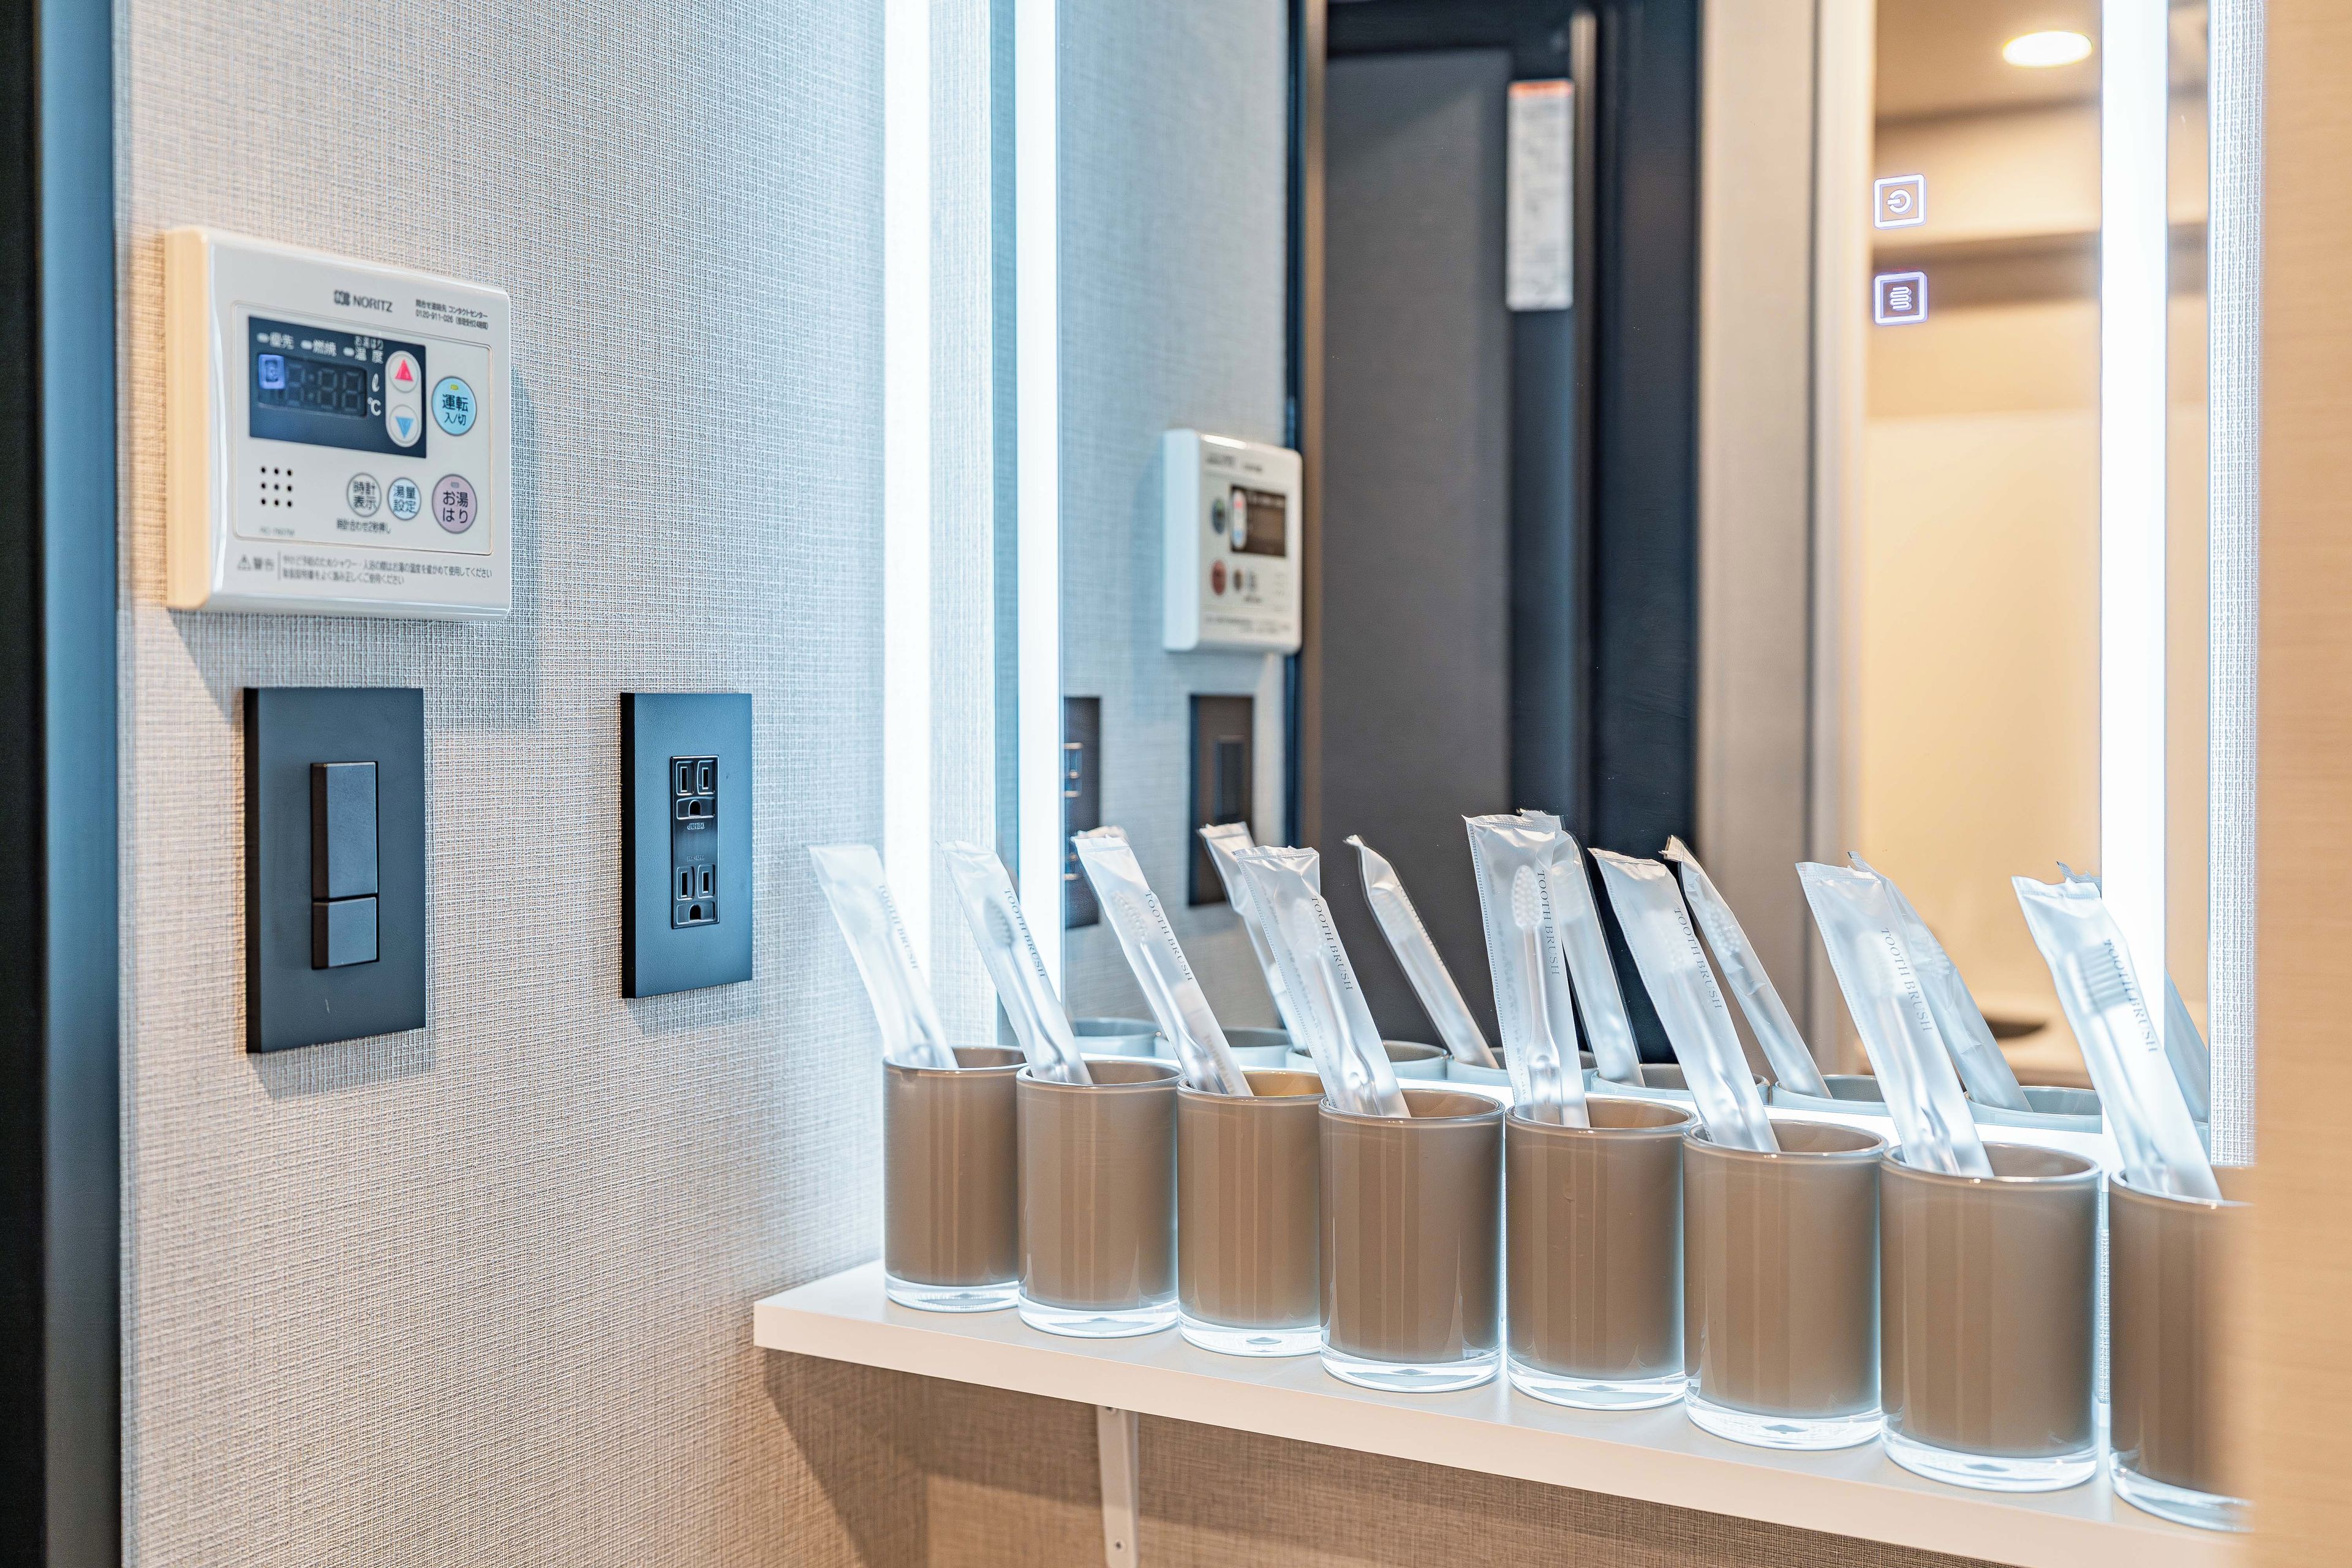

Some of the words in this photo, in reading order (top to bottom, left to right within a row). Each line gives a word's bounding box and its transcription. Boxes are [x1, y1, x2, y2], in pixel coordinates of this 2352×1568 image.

[353, 295, 393, 313] NORITZ
[448, 305, 488, 318] コンタクトセンター
[442, 394, 468, 412] 運転
[444, 412, 466, 426] 入/切
[353, 481, 375, 496] 時計
[393, 484, 416, 499] 湯量
[353, 496, 377, 511] 表示
[393, 499, 417, 514] 設定
[443, 491, 469, 508] お湯
[442, 507, 468, 524] はり
[878, 884, 900, 924] TOOTH
[897, 928, 919, 969] BRUSH
[1537, 870, 1551, 920] TOOTH
[1545, 925, 1560, 975] BRUSH
[1005, 888, 1027, 930] TOOTH
[1024, 935, 1045, 977] BRUSH
[1145, 890, 1169, 934] TOOTH
[1168, 938, 1193, 981] BRUSH
[1311, 895, 1334, 941] TOOTH
[1330, 945, 1353, 990] BRUSH
[1674, 907, 1700, 956] TOOTH
[1697, 960, 1722, 1008] BRUSH
[1881, 927, 1910, 975] TOOTH
[1904, 981, 1932, 1031] BRUSH
[2103, 939, 2135, 992] TOOTH
[2129, 997, 2158, 1052] BRUSH
